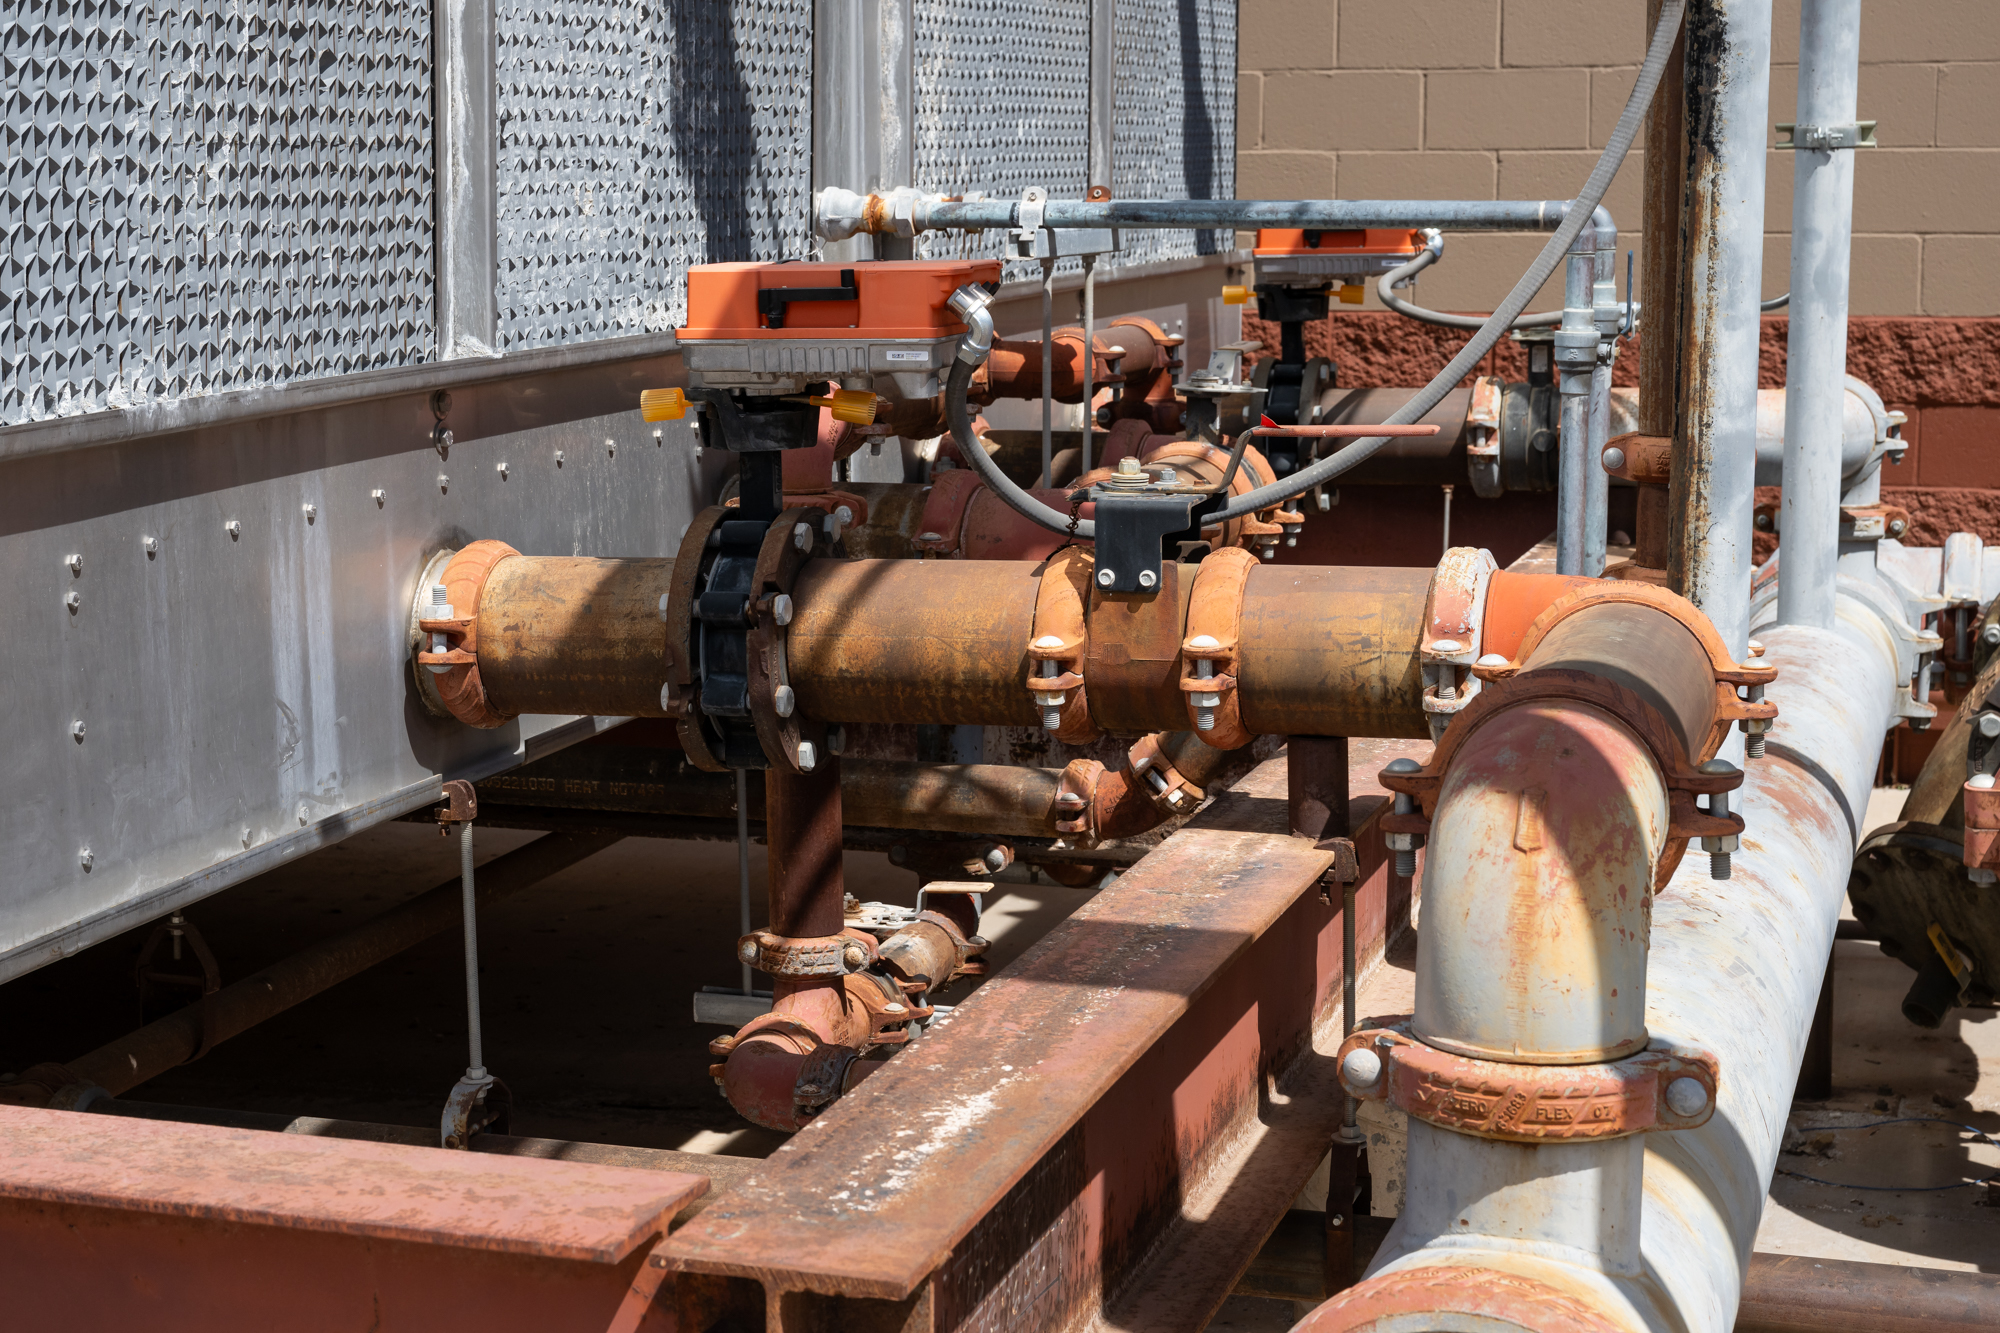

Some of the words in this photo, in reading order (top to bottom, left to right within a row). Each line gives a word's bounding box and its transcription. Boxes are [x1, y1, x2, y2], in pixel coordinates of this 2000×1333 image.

[564, 779, 600, 794] HEAT
[1450, 1096, 1488, 1114] ZERO
[1534, 1106, 1574, 1121] FLEX
